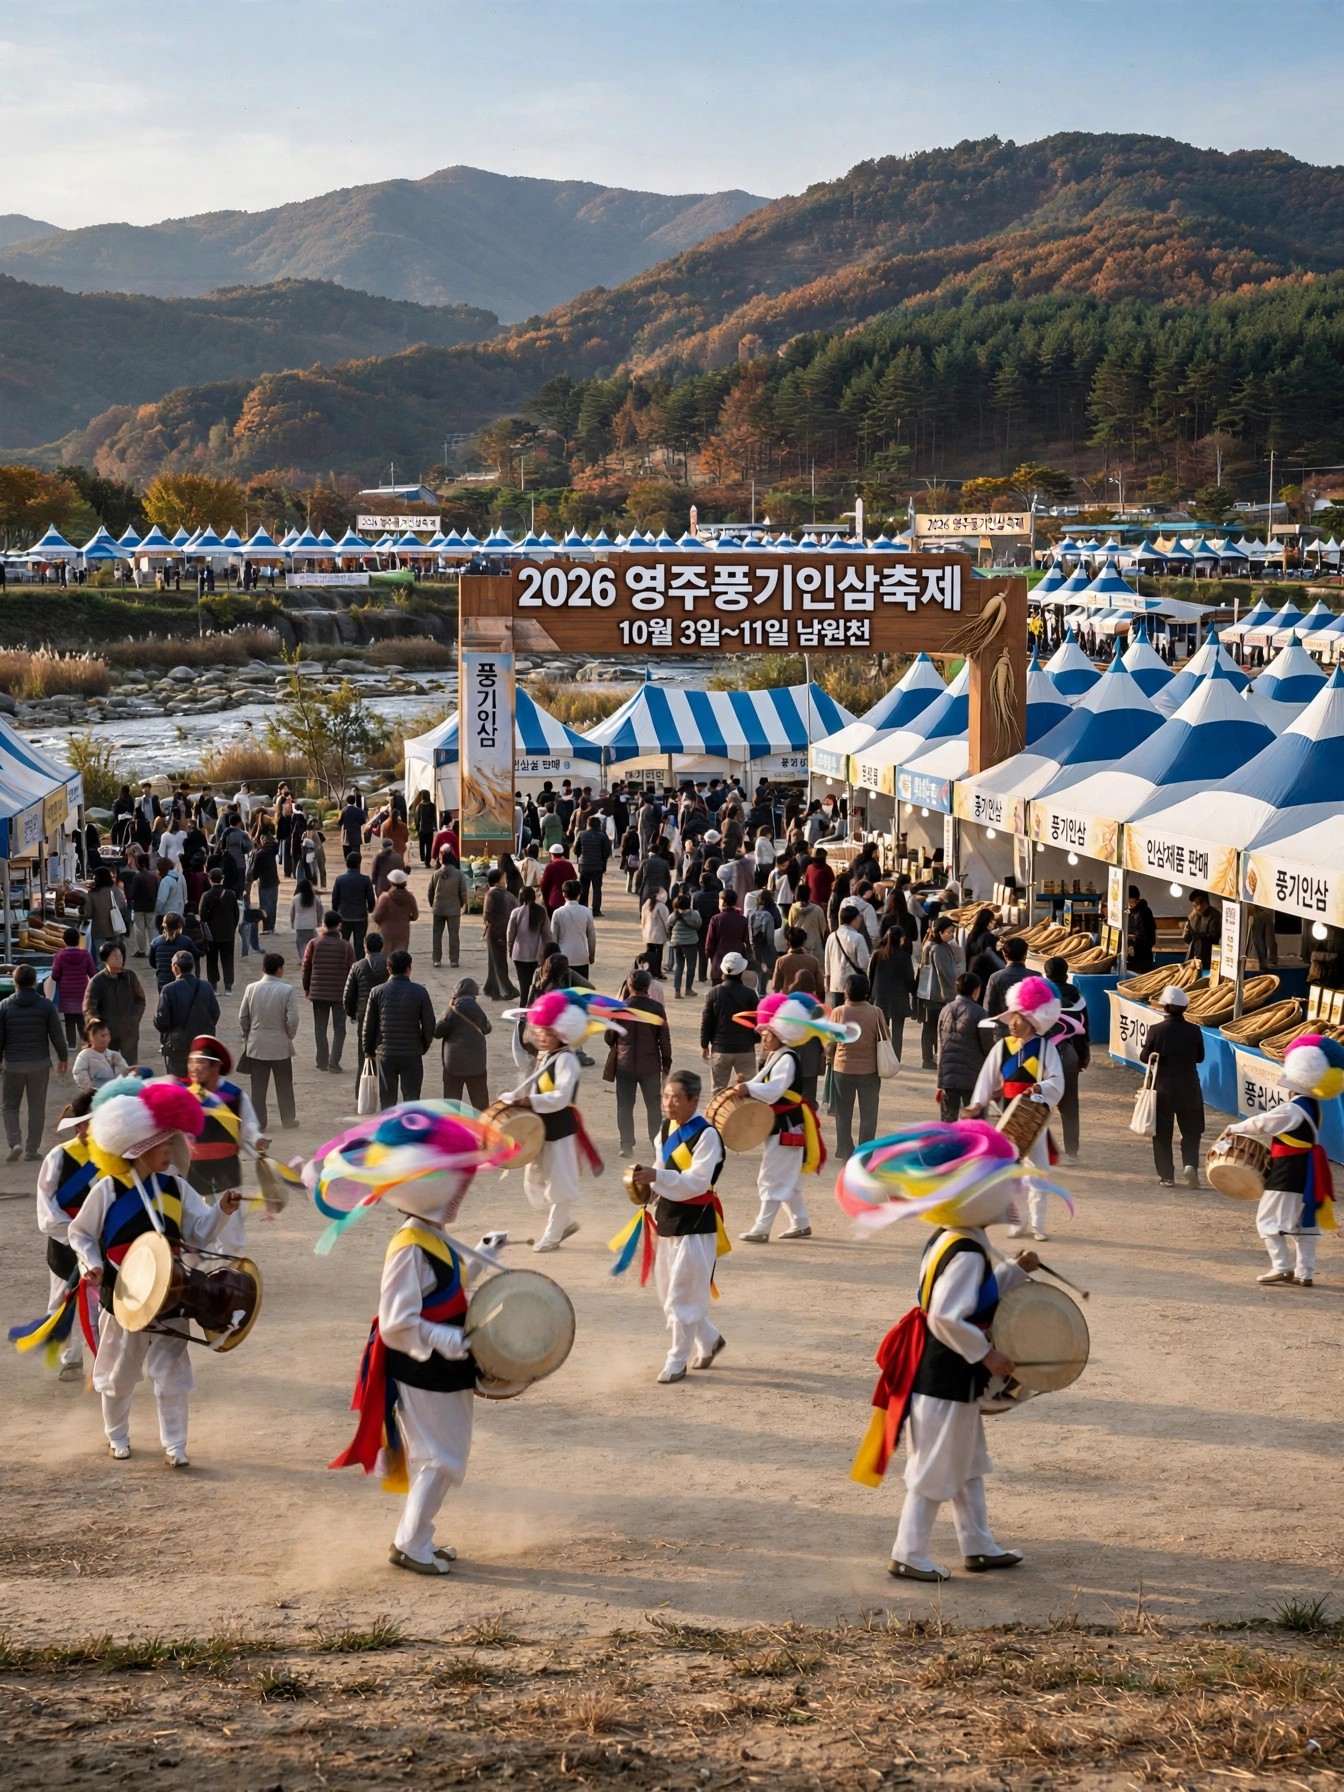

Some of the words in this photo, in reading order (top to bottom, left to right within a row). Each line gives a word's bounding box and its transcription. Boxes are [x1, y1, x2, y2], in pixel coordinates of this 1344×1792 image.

[518, 566, 617, 607] 2026
[625, 564, 962, 611] 영주풍기인삼축제
[619, 618, 673, 647] 10월
[680, 618, 789, 646] 3일~11일
[797, 618, 871, 647] 남원천
[974, 795, 1003, 822] 풍기인삼
[1051, 814, 1087, 847] 풍기인삼
[1188, 849, 1209, 880] 판매
[1275, 869, 1329, 912] 풍기인삼
